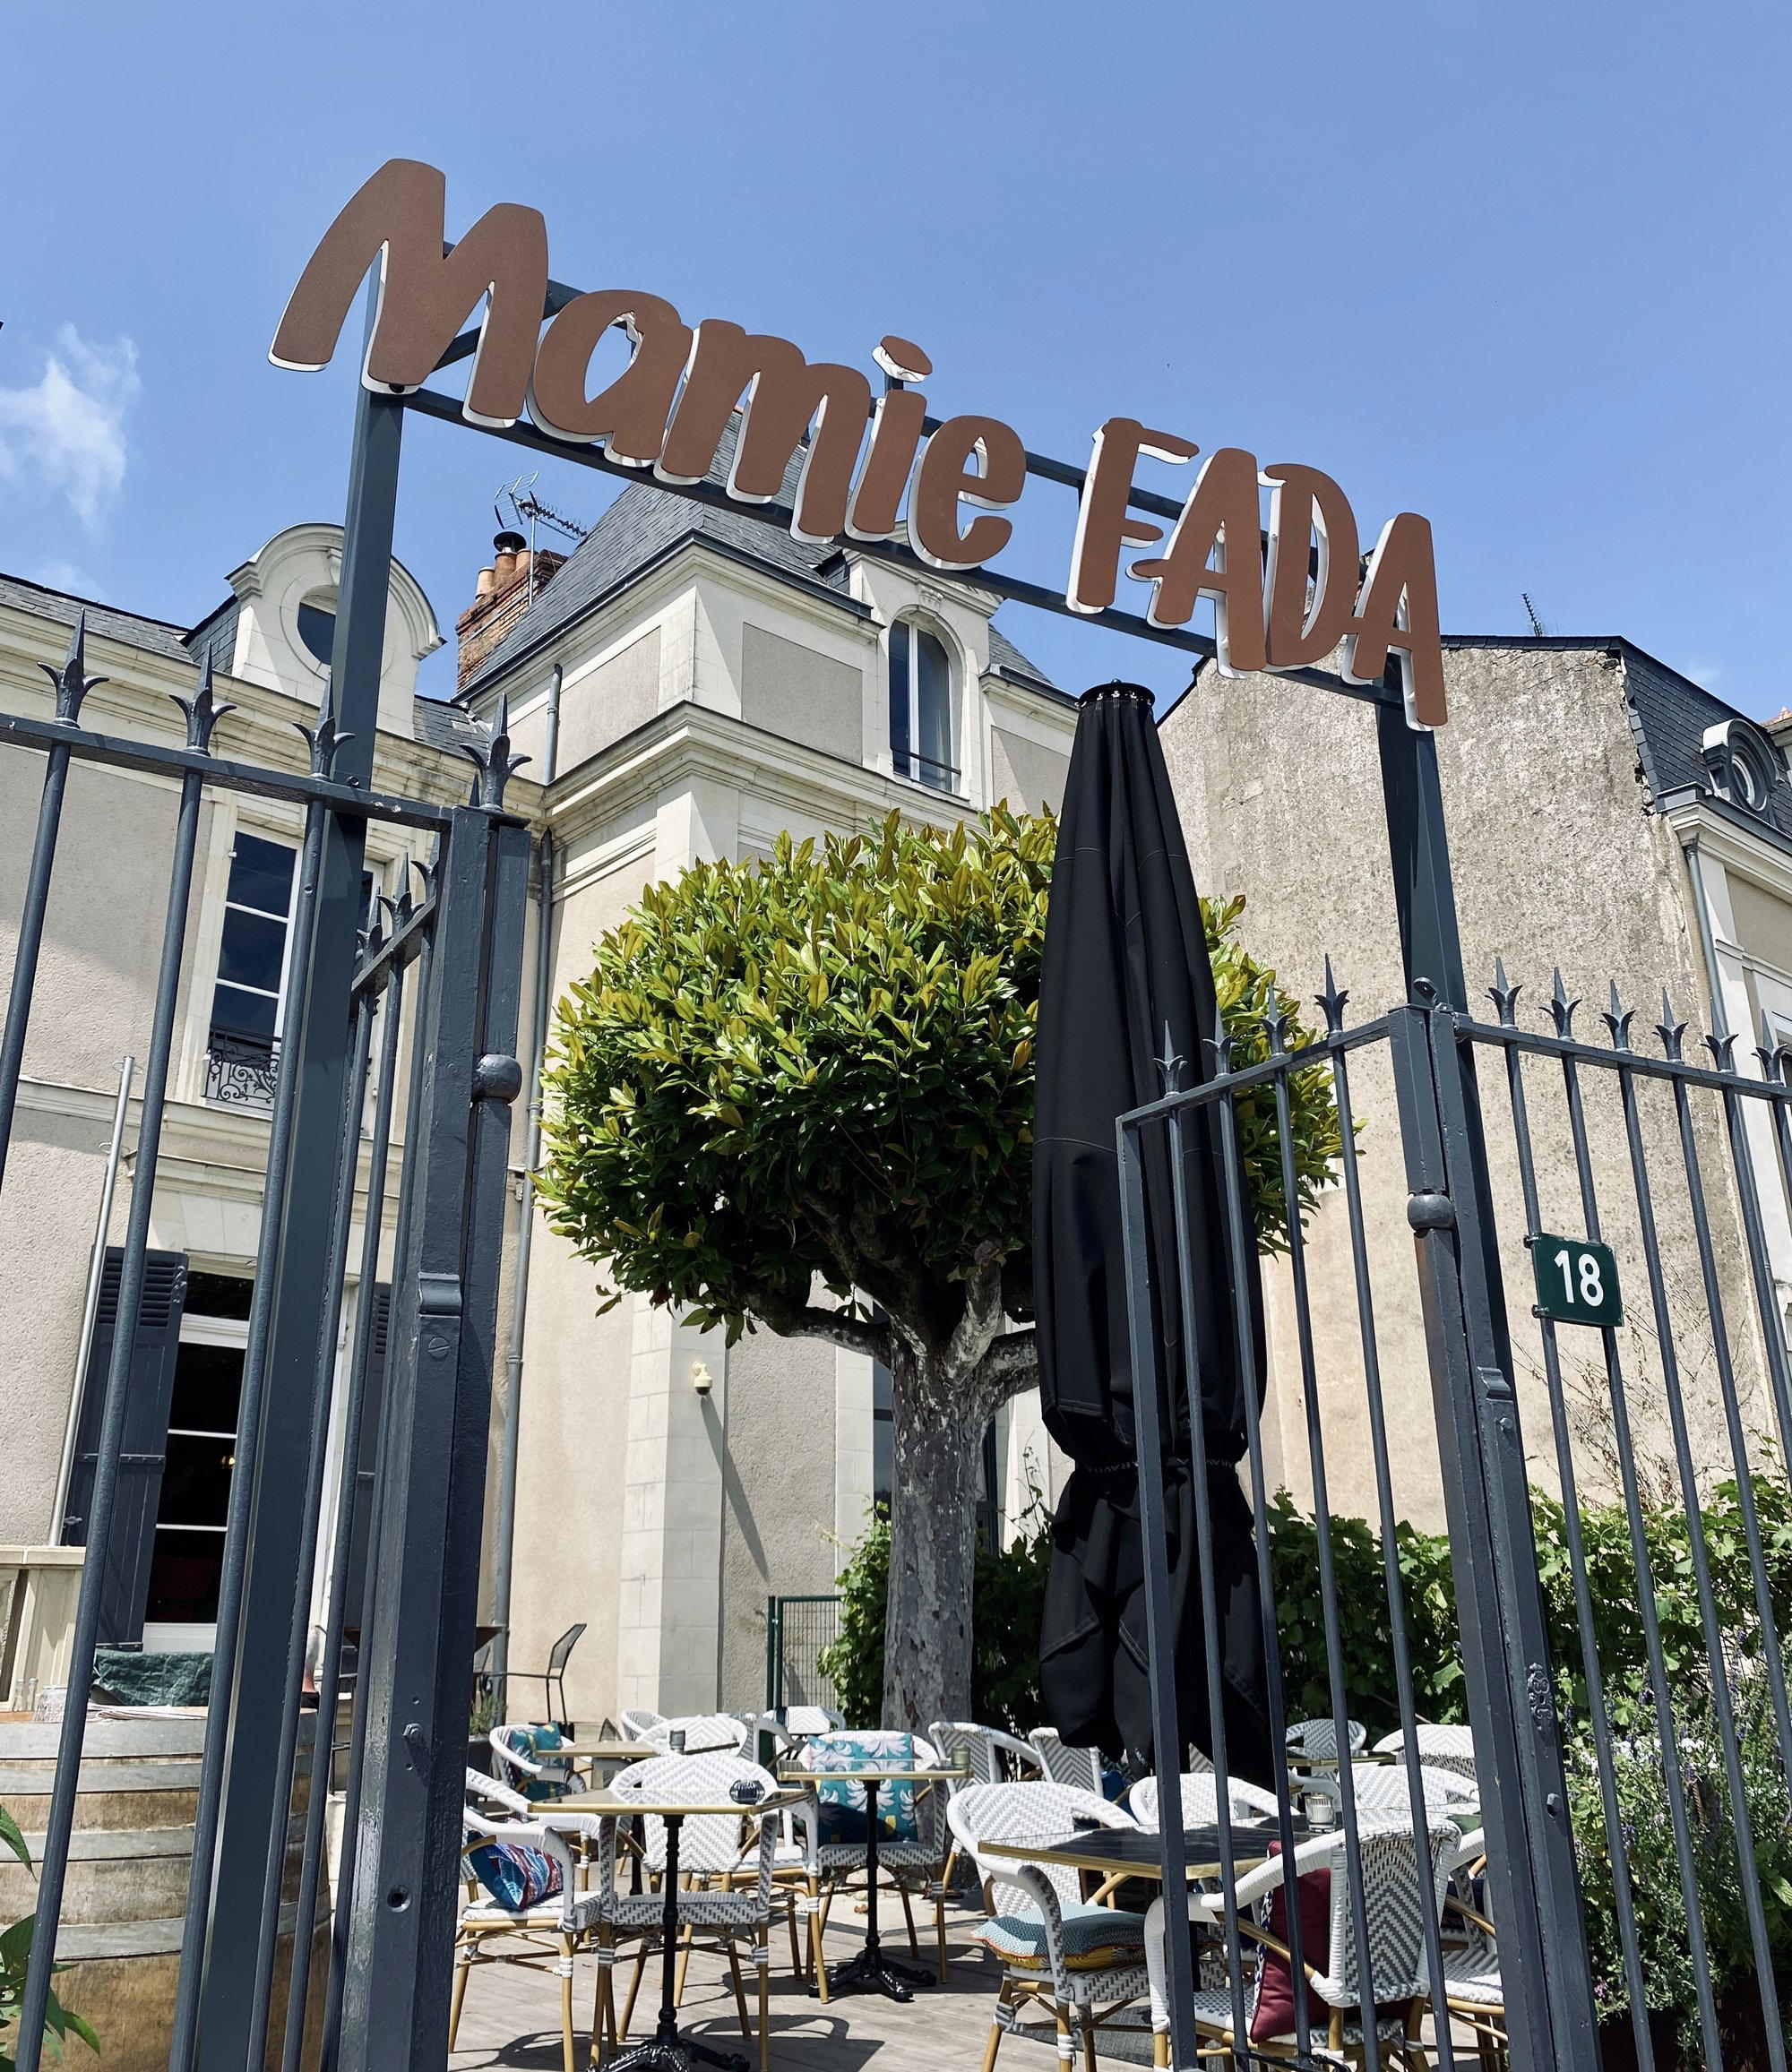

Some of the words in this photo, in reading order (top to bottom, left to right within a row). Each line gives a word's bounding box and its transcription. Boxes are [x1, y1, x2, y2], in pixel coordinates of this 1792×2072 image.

[268, 159, 1027, 571] Mamie
[1067, 417, 1448, 731] FADA
[1554, 1250, 1604, 1307] 18
